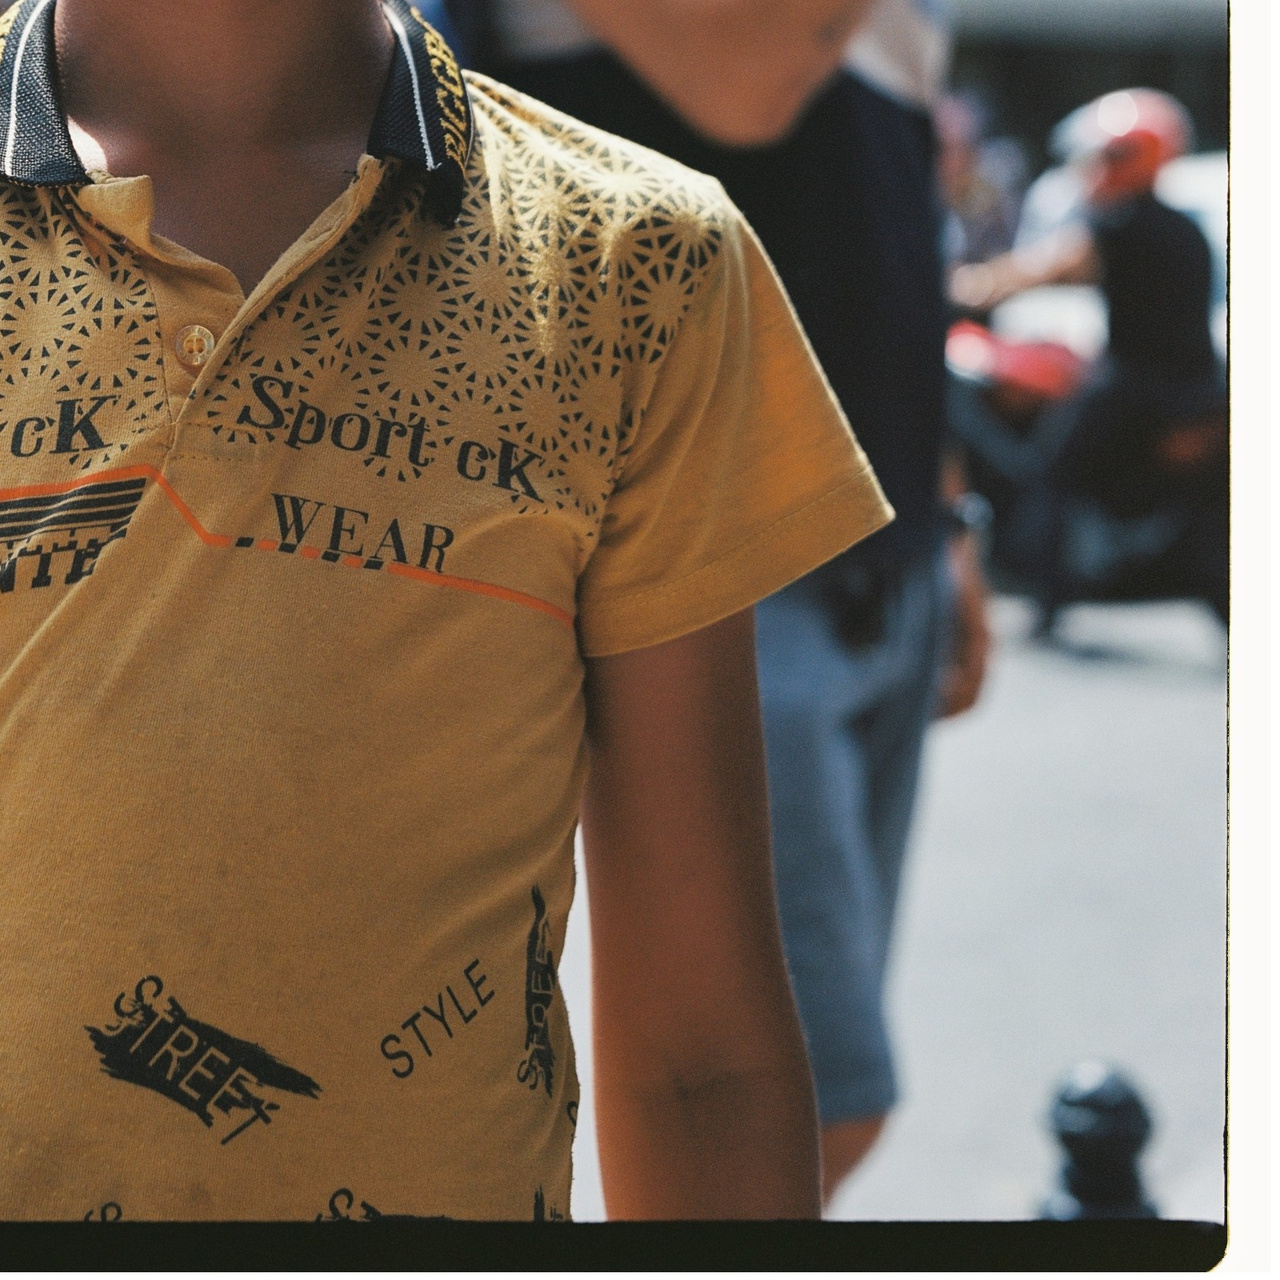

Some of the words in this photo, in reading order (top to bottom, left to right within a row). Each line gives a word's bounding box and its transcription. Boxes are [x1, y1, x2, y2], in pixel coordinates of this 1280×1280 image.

[237, 375, 430, 468] Sport
[271, 493, 455, 573] WEAR
[105, 974, 280, 1145] STREET
[380, 958, 495, 1079] STYLE
